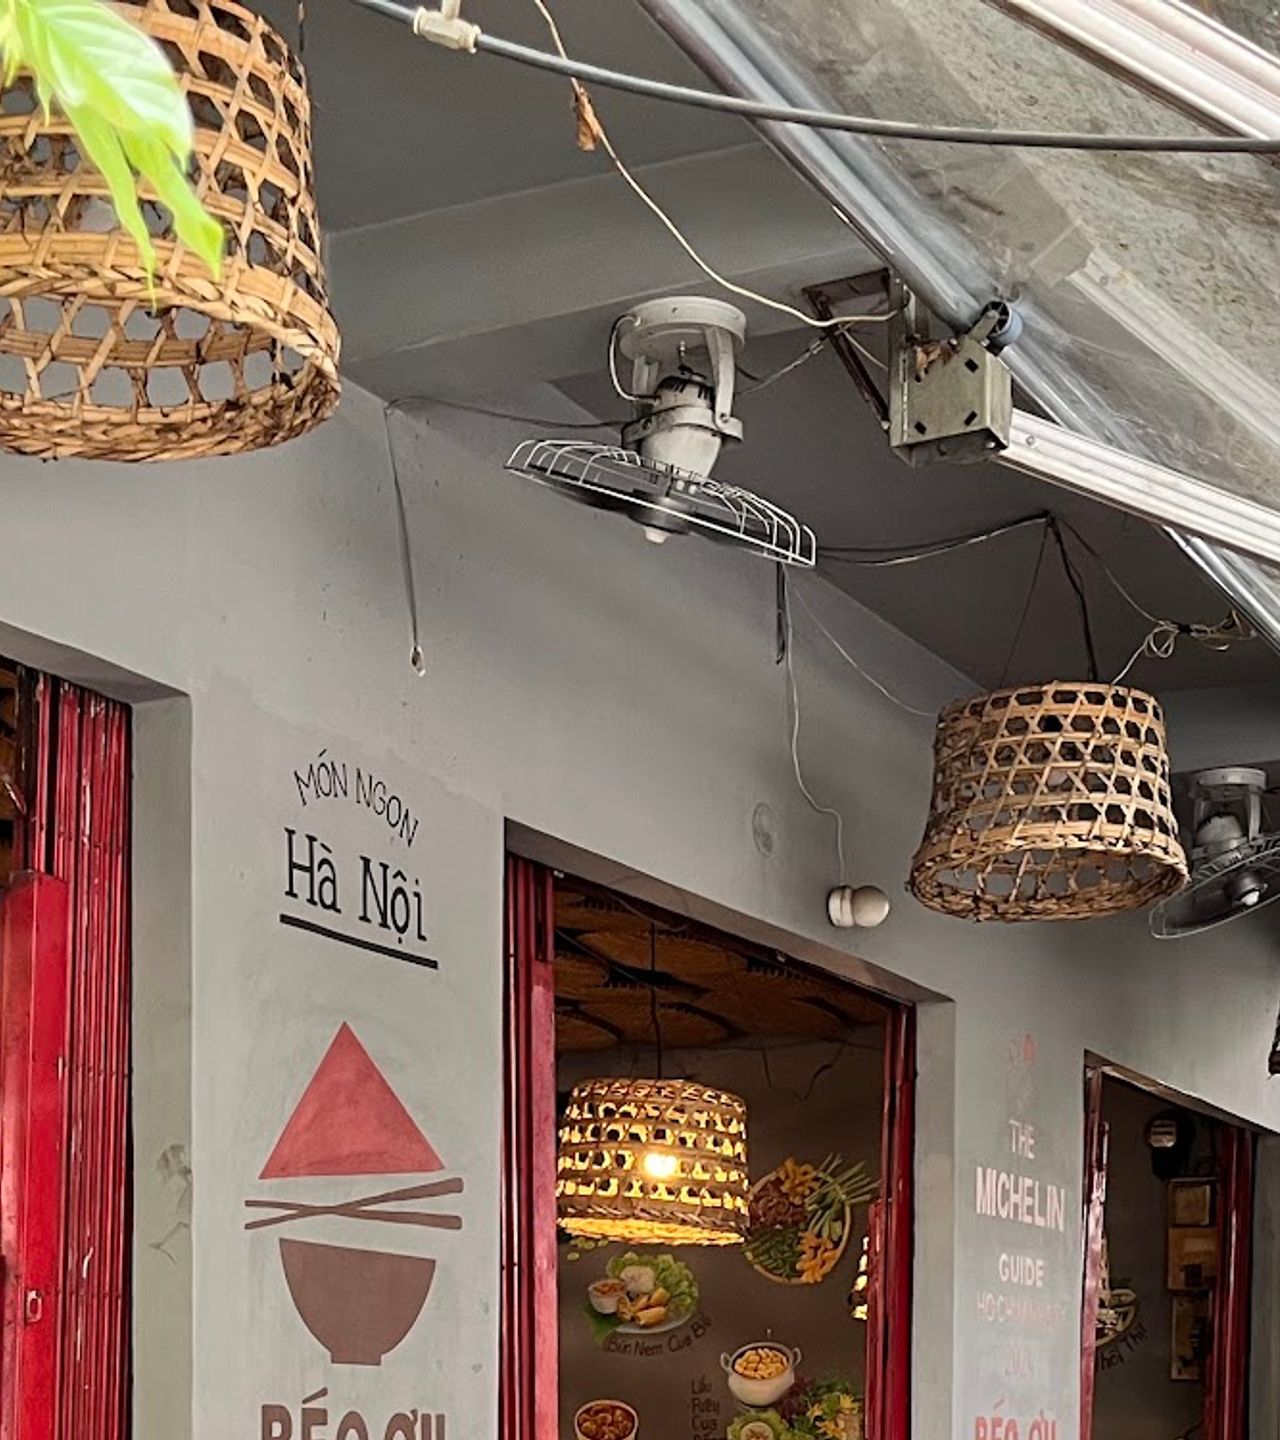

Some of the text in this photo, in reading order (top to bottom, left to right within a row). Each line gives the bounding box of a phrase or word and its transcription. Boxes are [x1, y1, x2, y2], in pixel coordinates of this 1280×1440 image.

[294, 749, 419, 848] MÓN NGON
[284, 827, 428, 945] Hà Nội
[1009, 1118, 1035, 1160] THE
[975, 1166, 1065, 1233] MICHELIN
[998, 1252, 1045, 1288] GUIDE
